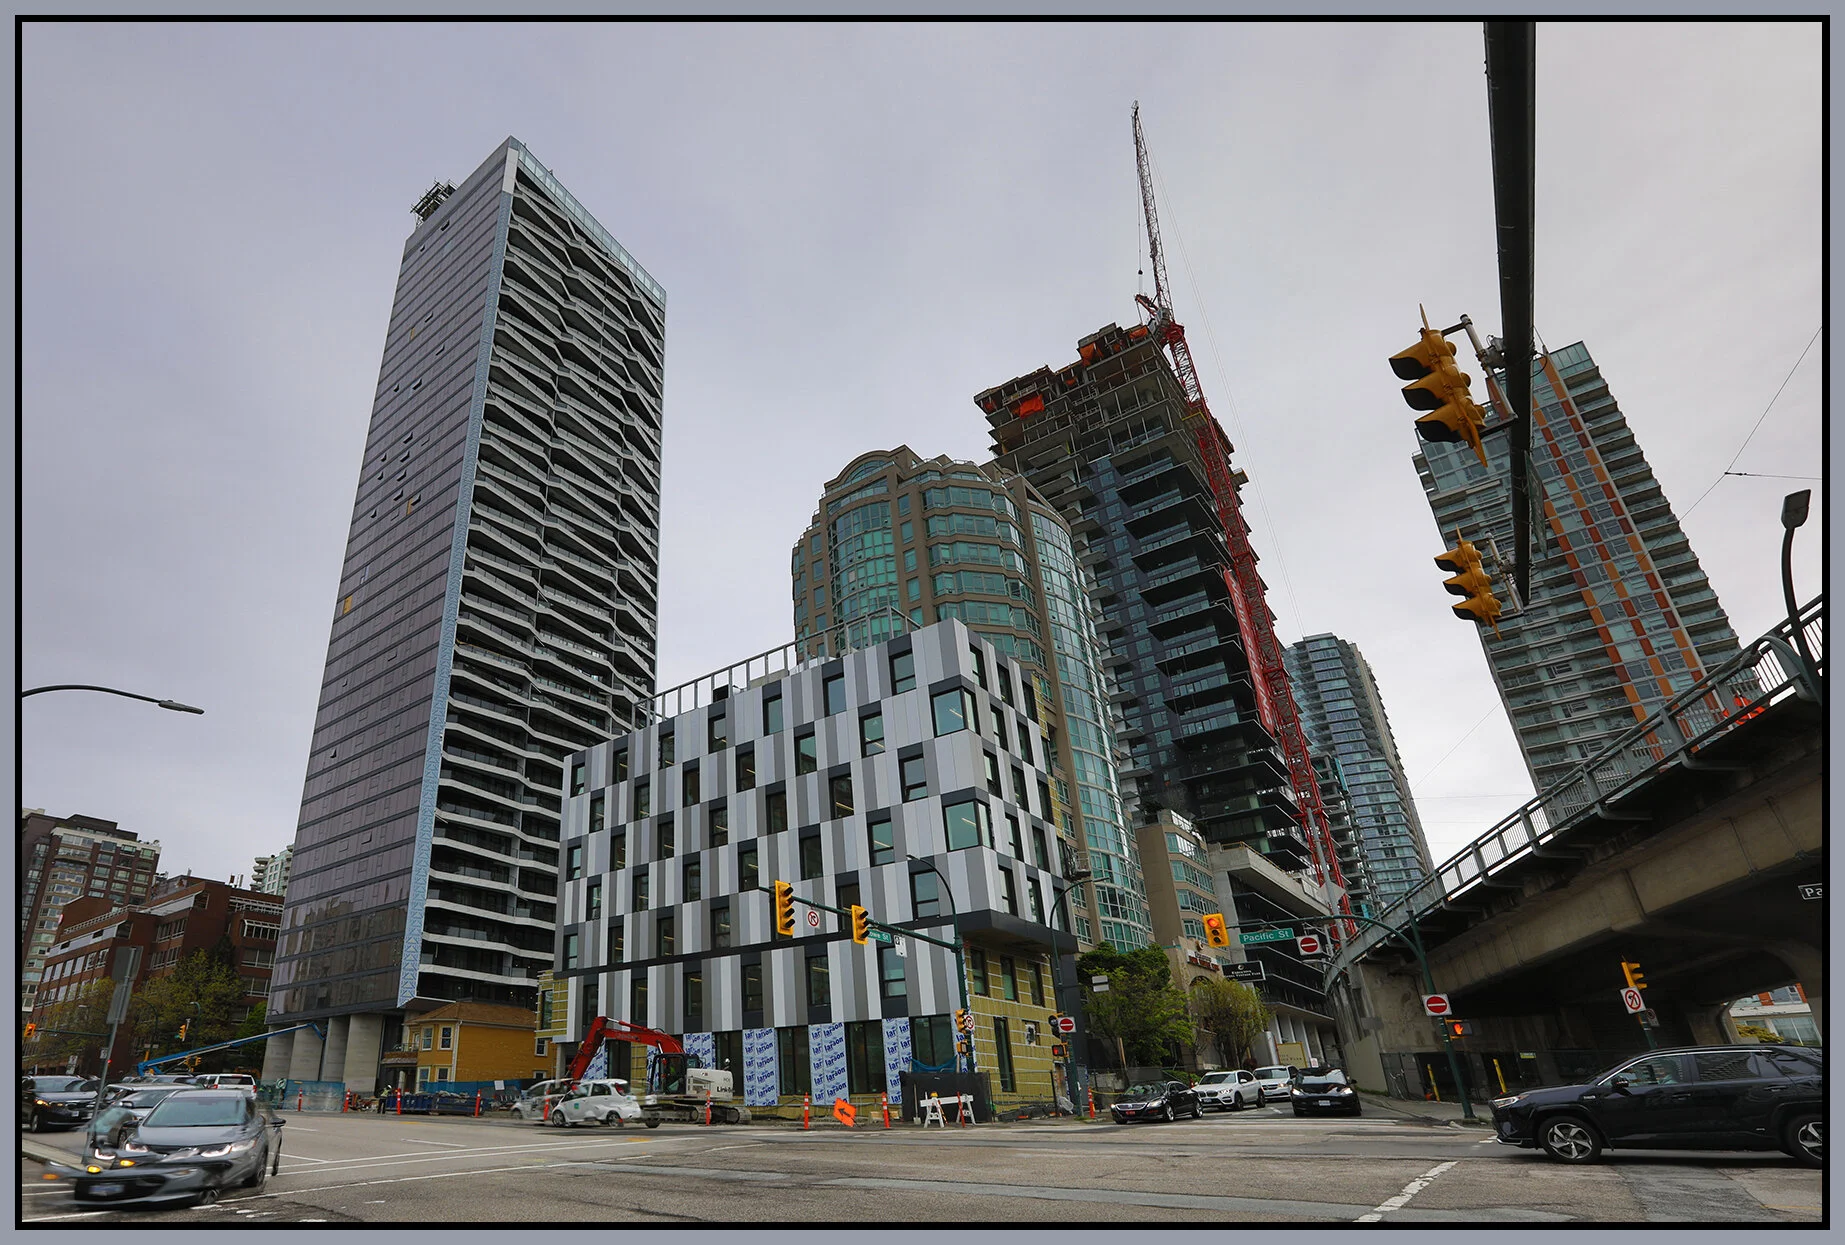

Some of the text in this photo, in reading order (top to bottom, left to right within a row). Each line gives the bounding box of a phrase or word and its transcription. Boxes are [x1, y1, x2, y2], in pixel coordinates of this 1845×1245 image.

[1243, 929, 1290, 942] Pacific St
[823, 1022, 843, 1037] larson
[756, 1042, 774, 1054] larson
[824, 1037, 844, 1052] larson
[756, 1056, 774, 1068] larson
[825, 1052, 845, 1067] larson
[757, 1070, 775, 1083] larson
[826, 1067, 846, 1081] larson
[757, 1085, 775, 1098] larson
[827, 1082, 847, 1097] larson
